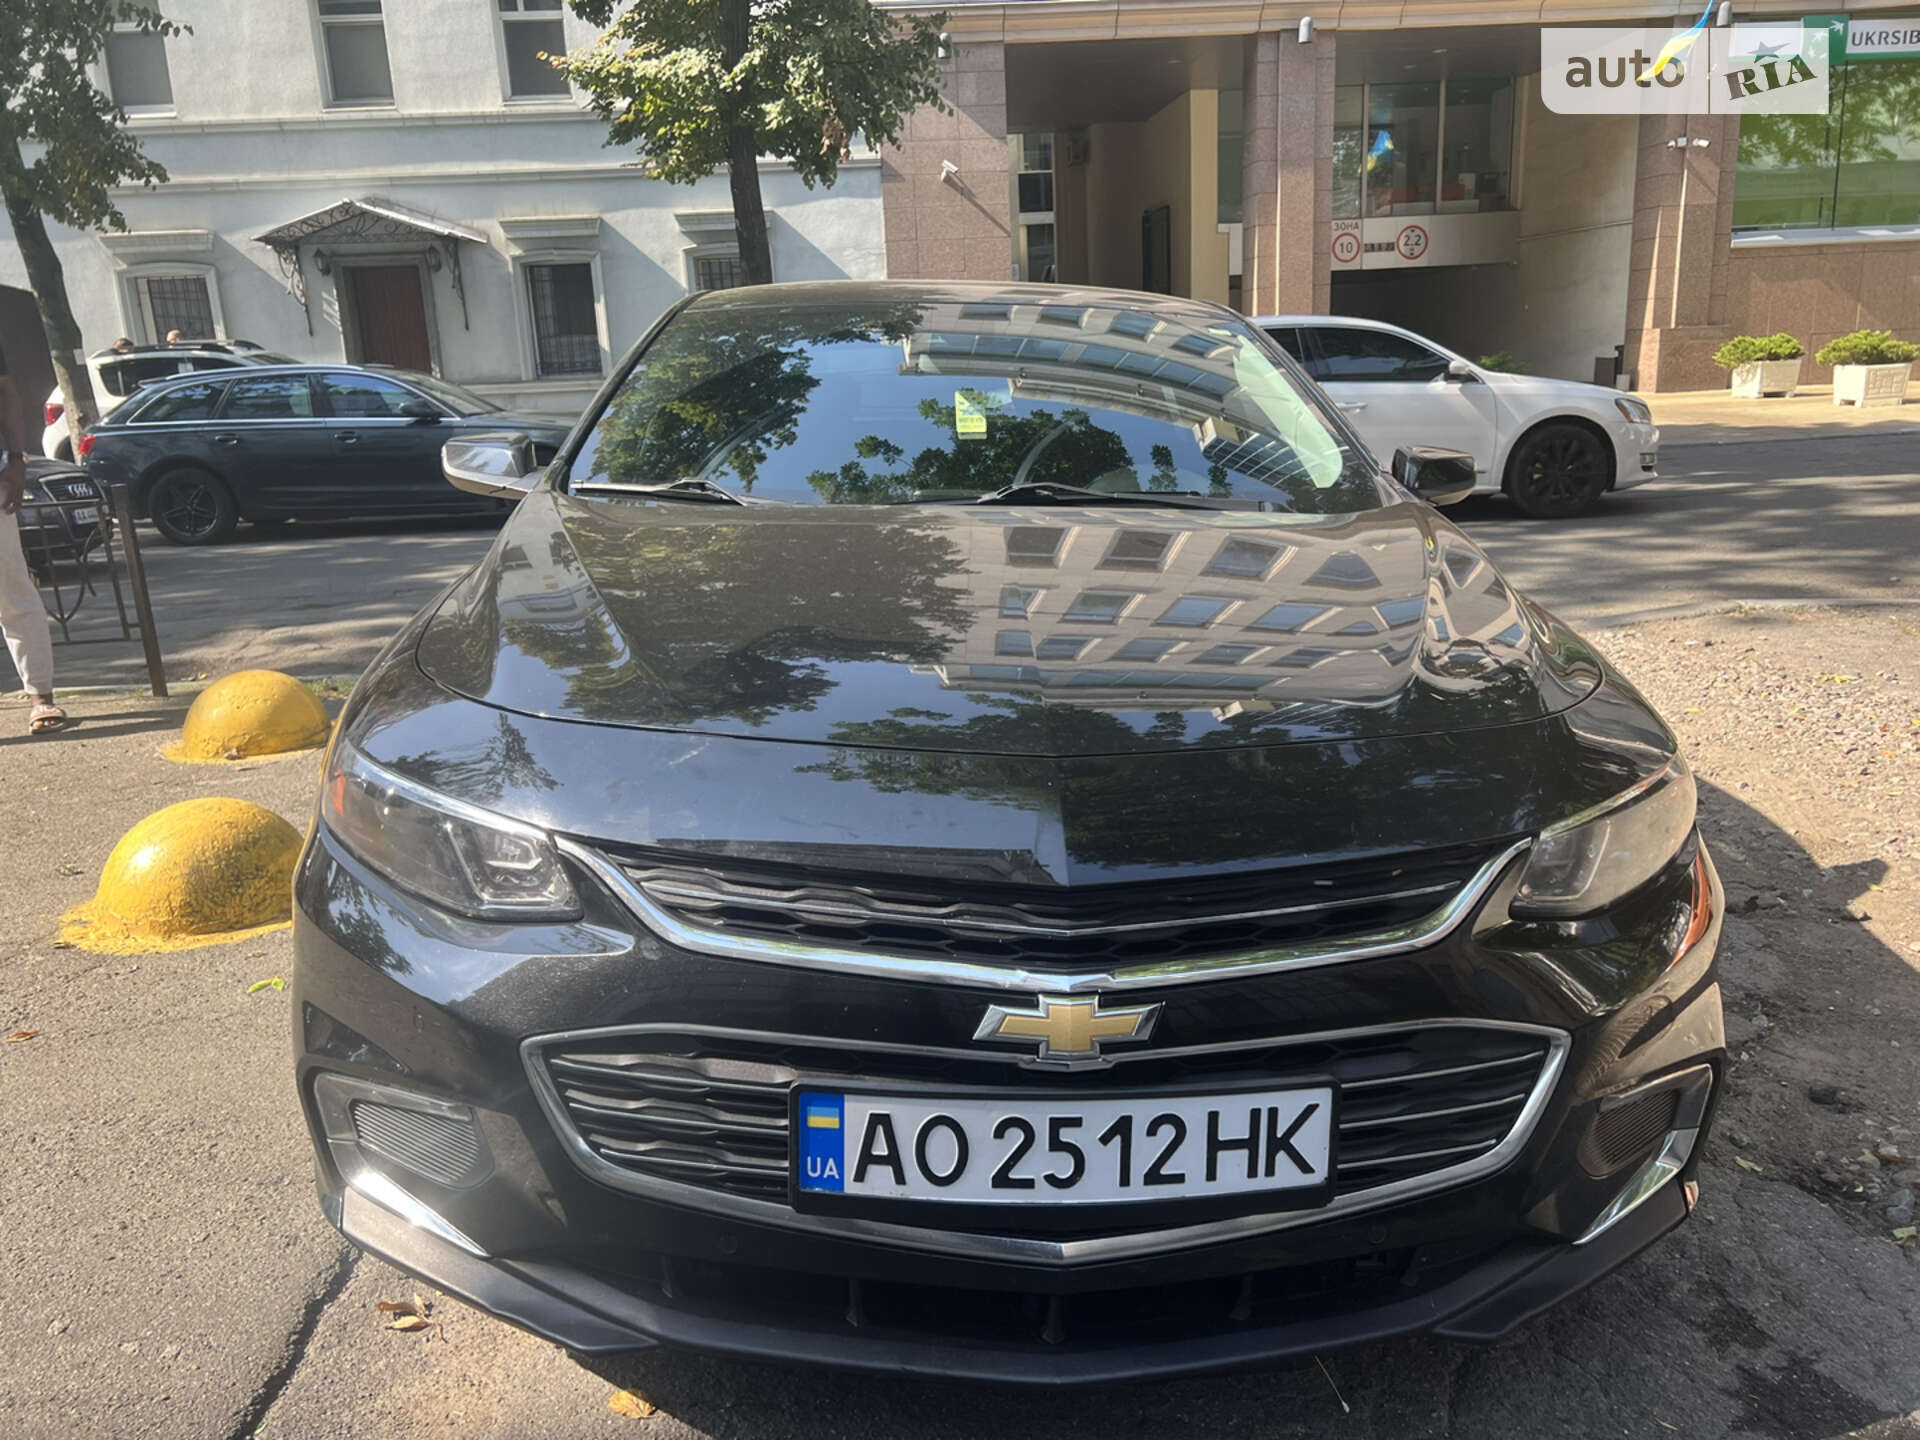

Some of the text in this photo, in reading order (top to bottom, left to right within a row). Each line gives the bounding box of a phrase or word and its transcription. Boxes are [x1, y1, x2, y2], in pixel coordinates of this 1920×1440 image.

[1334, 222, 1359, 231] ЗОНА
[1338, 242, 1353, 253] 10
[852, 1103, 1320, 1189] AO 2512 HK
[807, 1157, 839, 1179] UA
